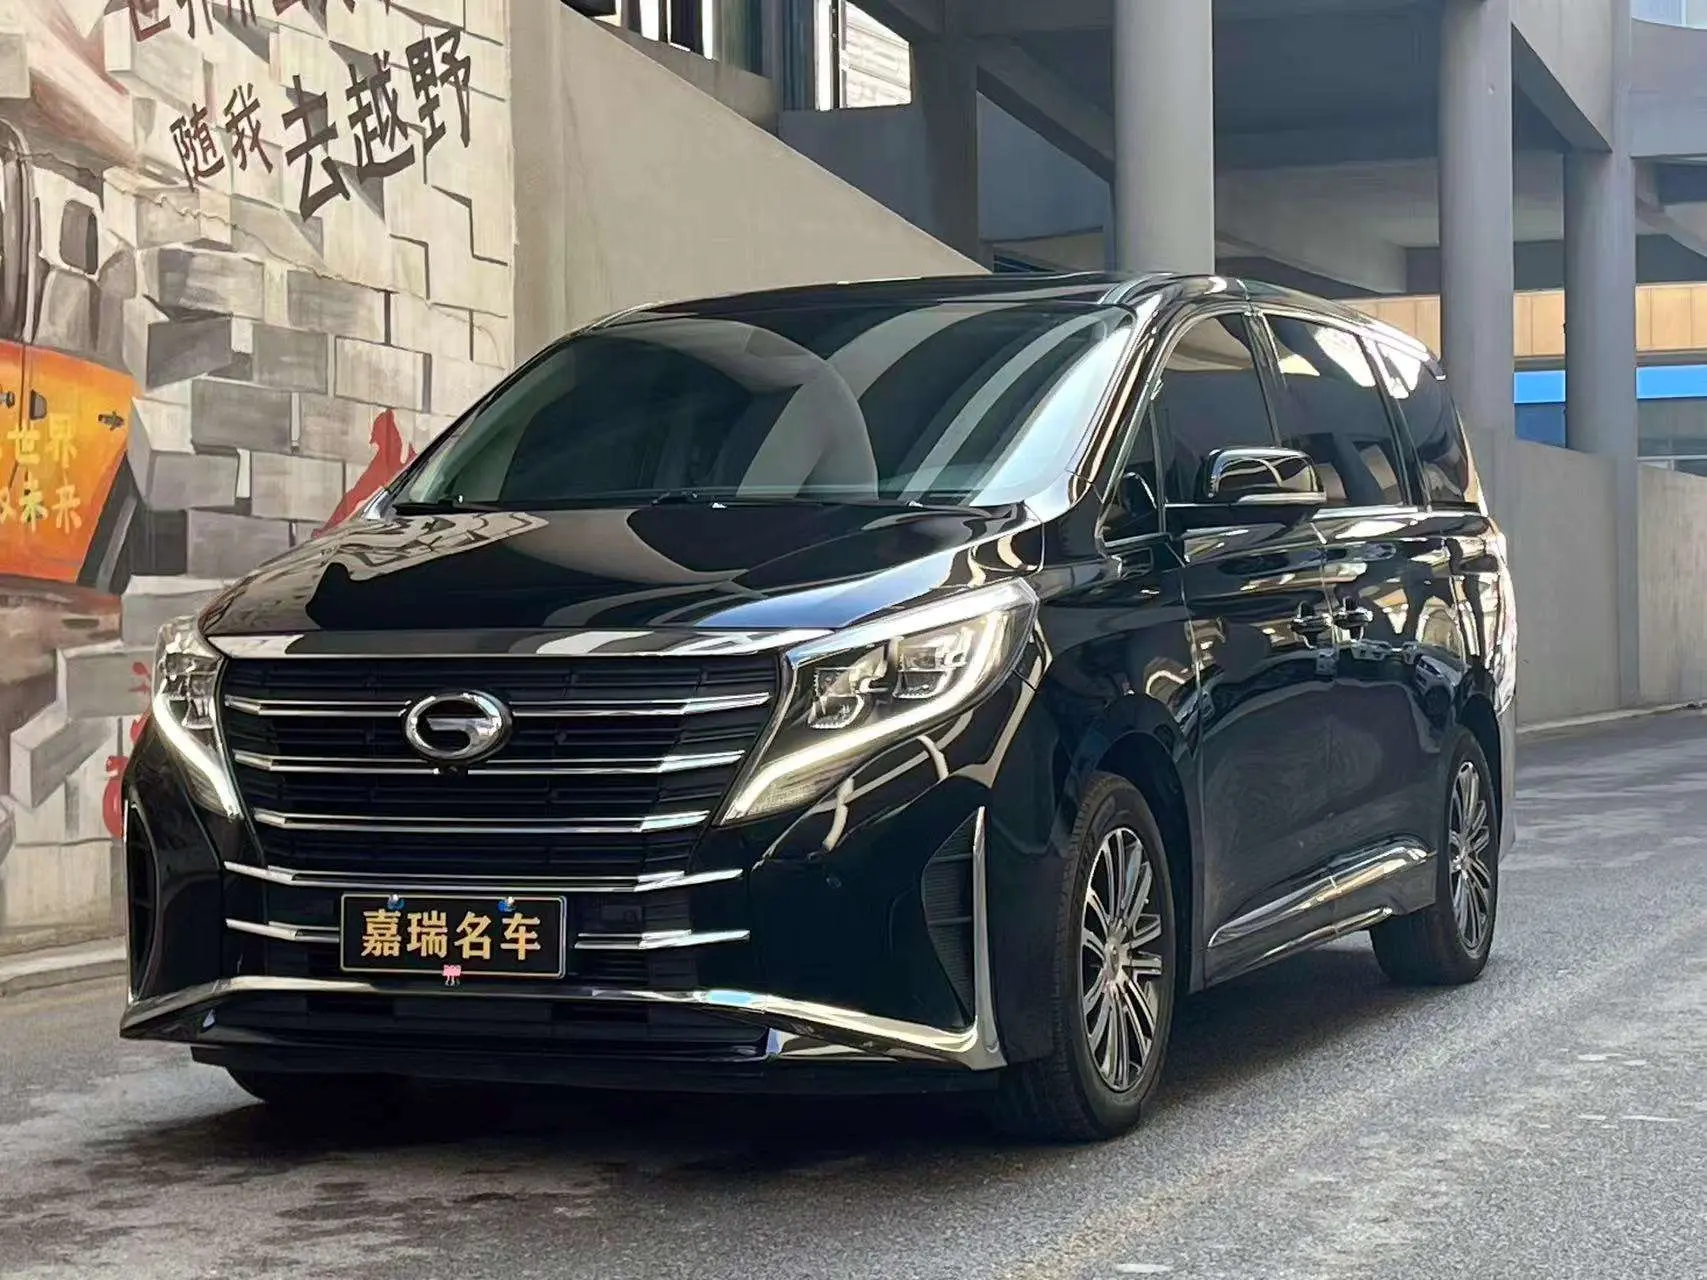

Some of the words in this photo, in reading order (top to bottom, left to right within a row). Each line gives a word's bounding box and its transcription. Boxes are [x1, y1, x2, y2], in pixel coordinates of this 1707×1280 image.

[169, 27, 471, 222] 随我去越野
[360, 908, 541, 961] 嘉瑞名车
